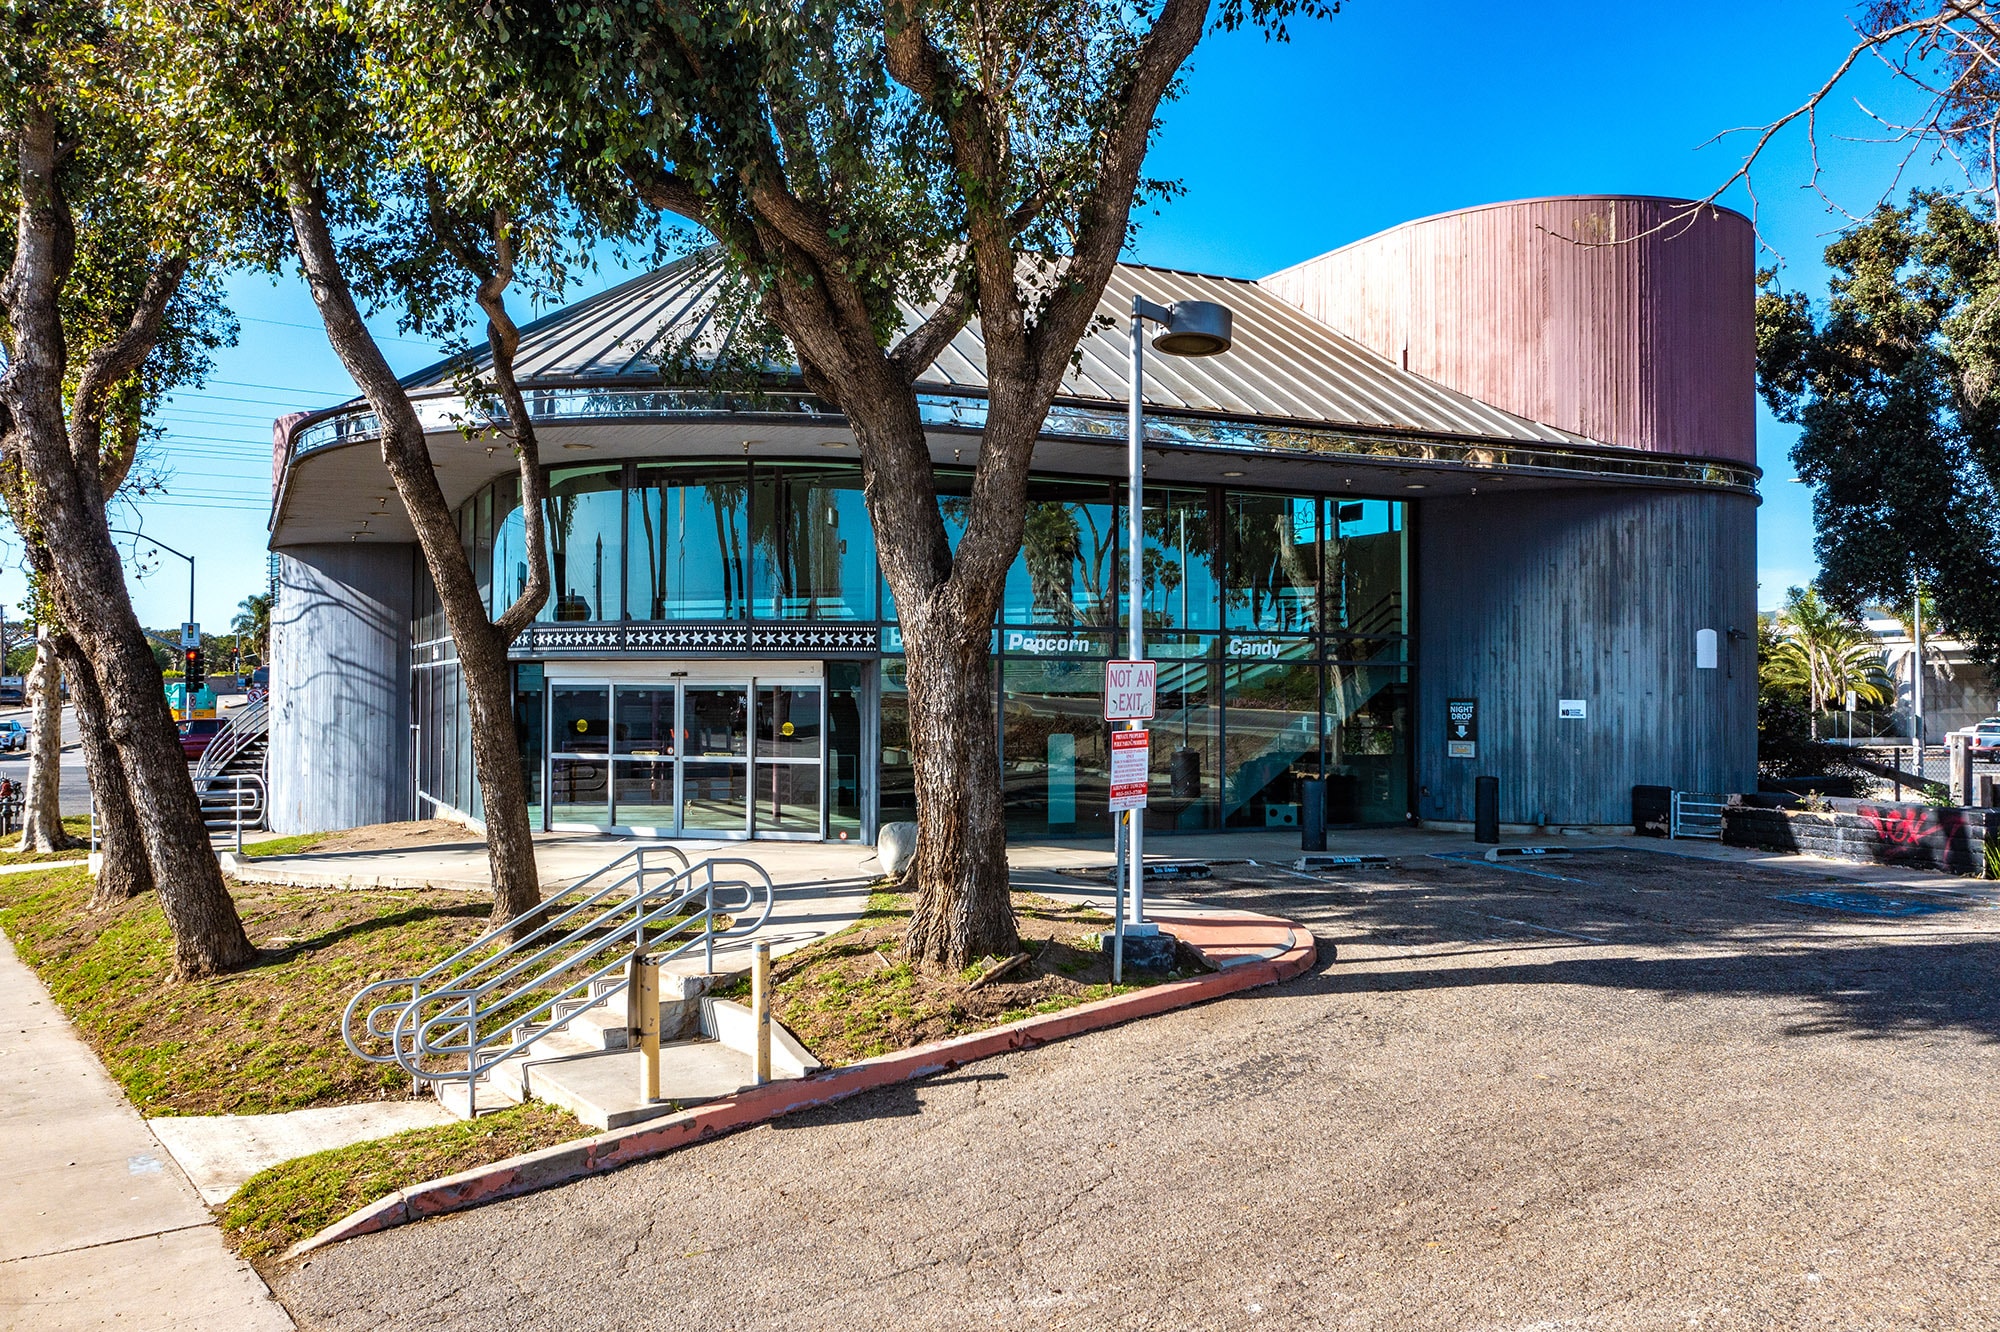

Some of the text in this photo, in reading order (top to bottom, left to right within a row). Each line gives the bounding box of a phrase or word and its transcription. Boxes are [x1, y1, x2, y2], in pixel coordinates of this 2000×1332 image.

[1009, 633, 1090, 655] Popcorn
[1229, 638, 1281, 659] Candy
[1110, 669, 1153, 688] NOT AN
[1119, 693, 1143, 711] EXIT
[1561, 709, 1570, 717] NO
